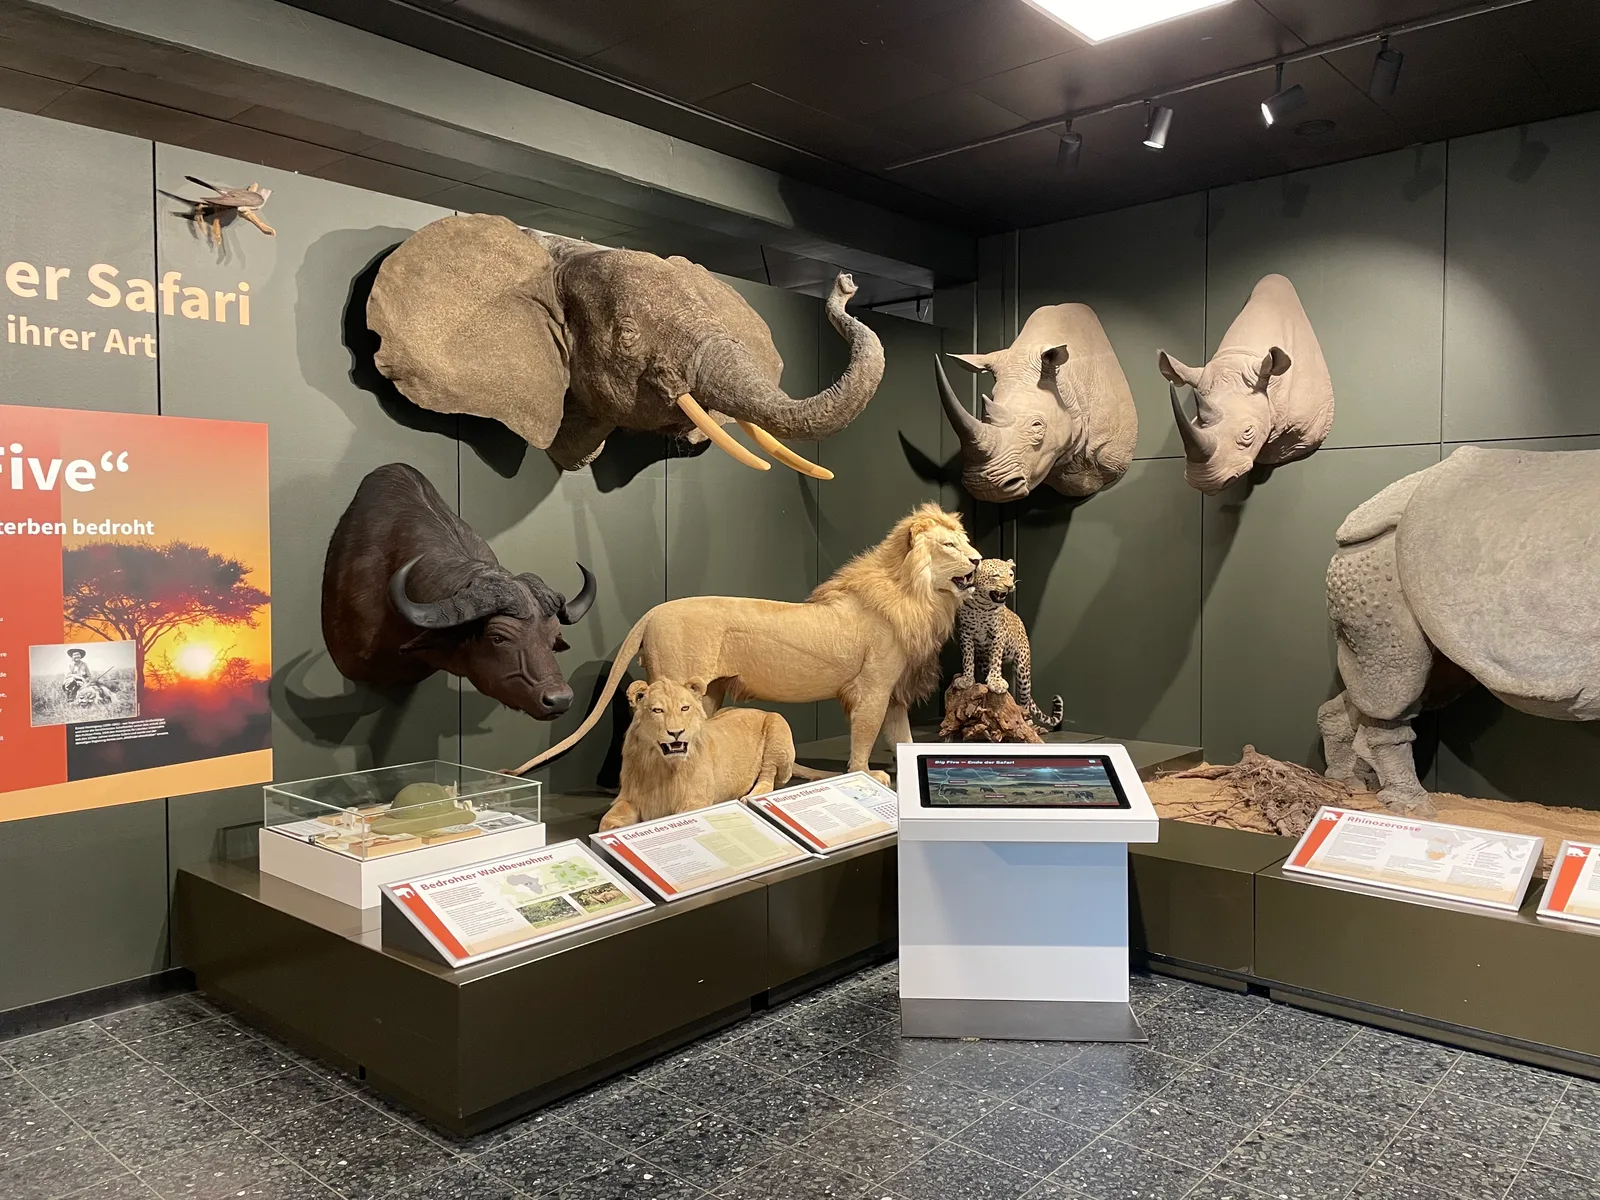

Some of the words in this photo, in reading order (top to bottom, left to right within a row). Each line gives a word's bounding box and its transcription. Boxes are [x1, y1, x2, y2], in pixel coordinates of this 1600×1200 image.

[5, 260, 70, 301] er
[87, 263, 251, 326] Safari
[7, 314, 96, 351] ihrer
[103, 328, 158, 358] Art
[72, 518, 154, 536] bedroht
[773, 793, 800, 804] Blutiges
[622, 828, 653, 841] Elefant
[655, 823, 668, 833] des
[669, 818, 698, 830] Waldes
[1347, 816, 1422, 833] Rhinozerosse
[420, 872, 477, 891] Bedrohter
[477, 854, 554, 876] Waldbewohner
